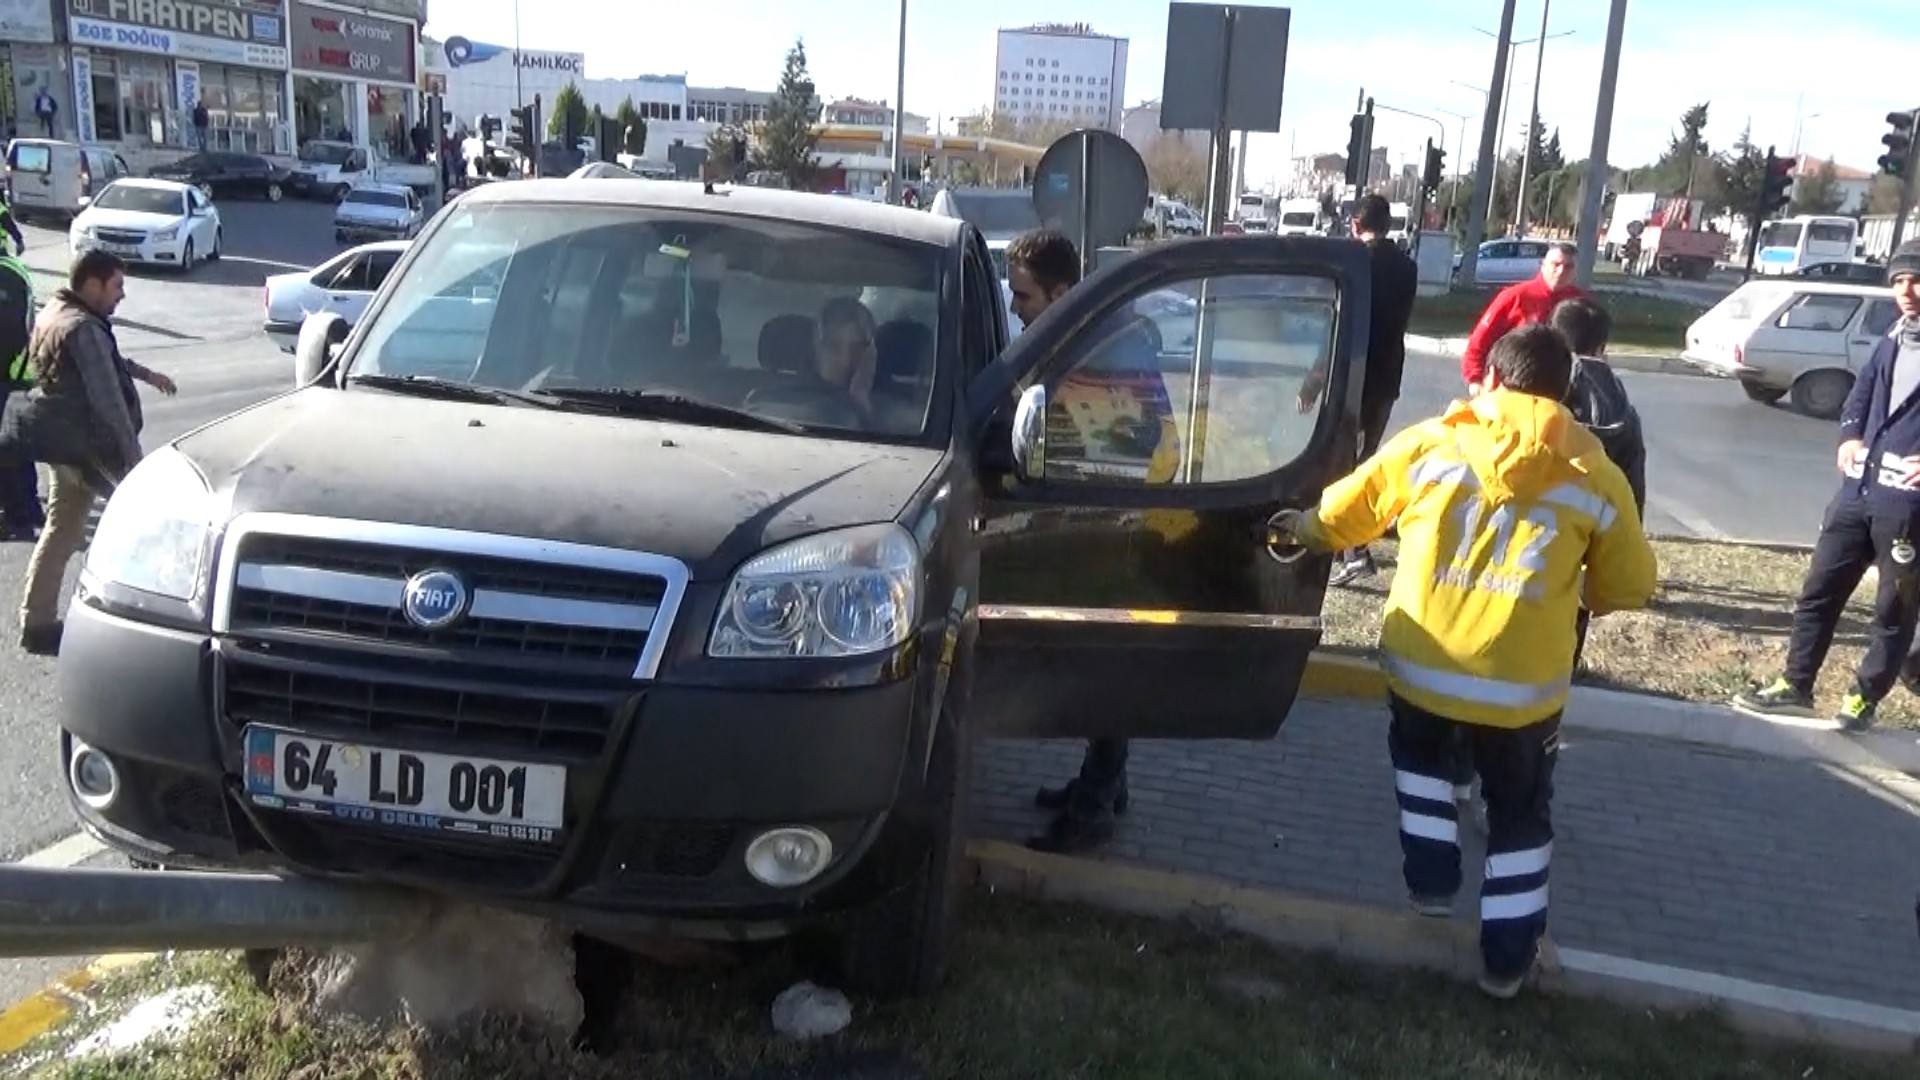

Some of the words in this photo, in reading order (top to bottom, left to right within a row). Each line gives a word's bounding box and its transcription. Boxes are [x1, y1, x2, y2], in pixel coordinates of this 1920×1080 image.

[109, 0, 249, 39] FIRATPEN
[1453, 493, 1558, 573] 112
[415, 588, 455, 609] FIAT
[284, 740, 338, 797] 64
[369, 750, 425, 806] LD
[449, 761, 527, 820] 001
